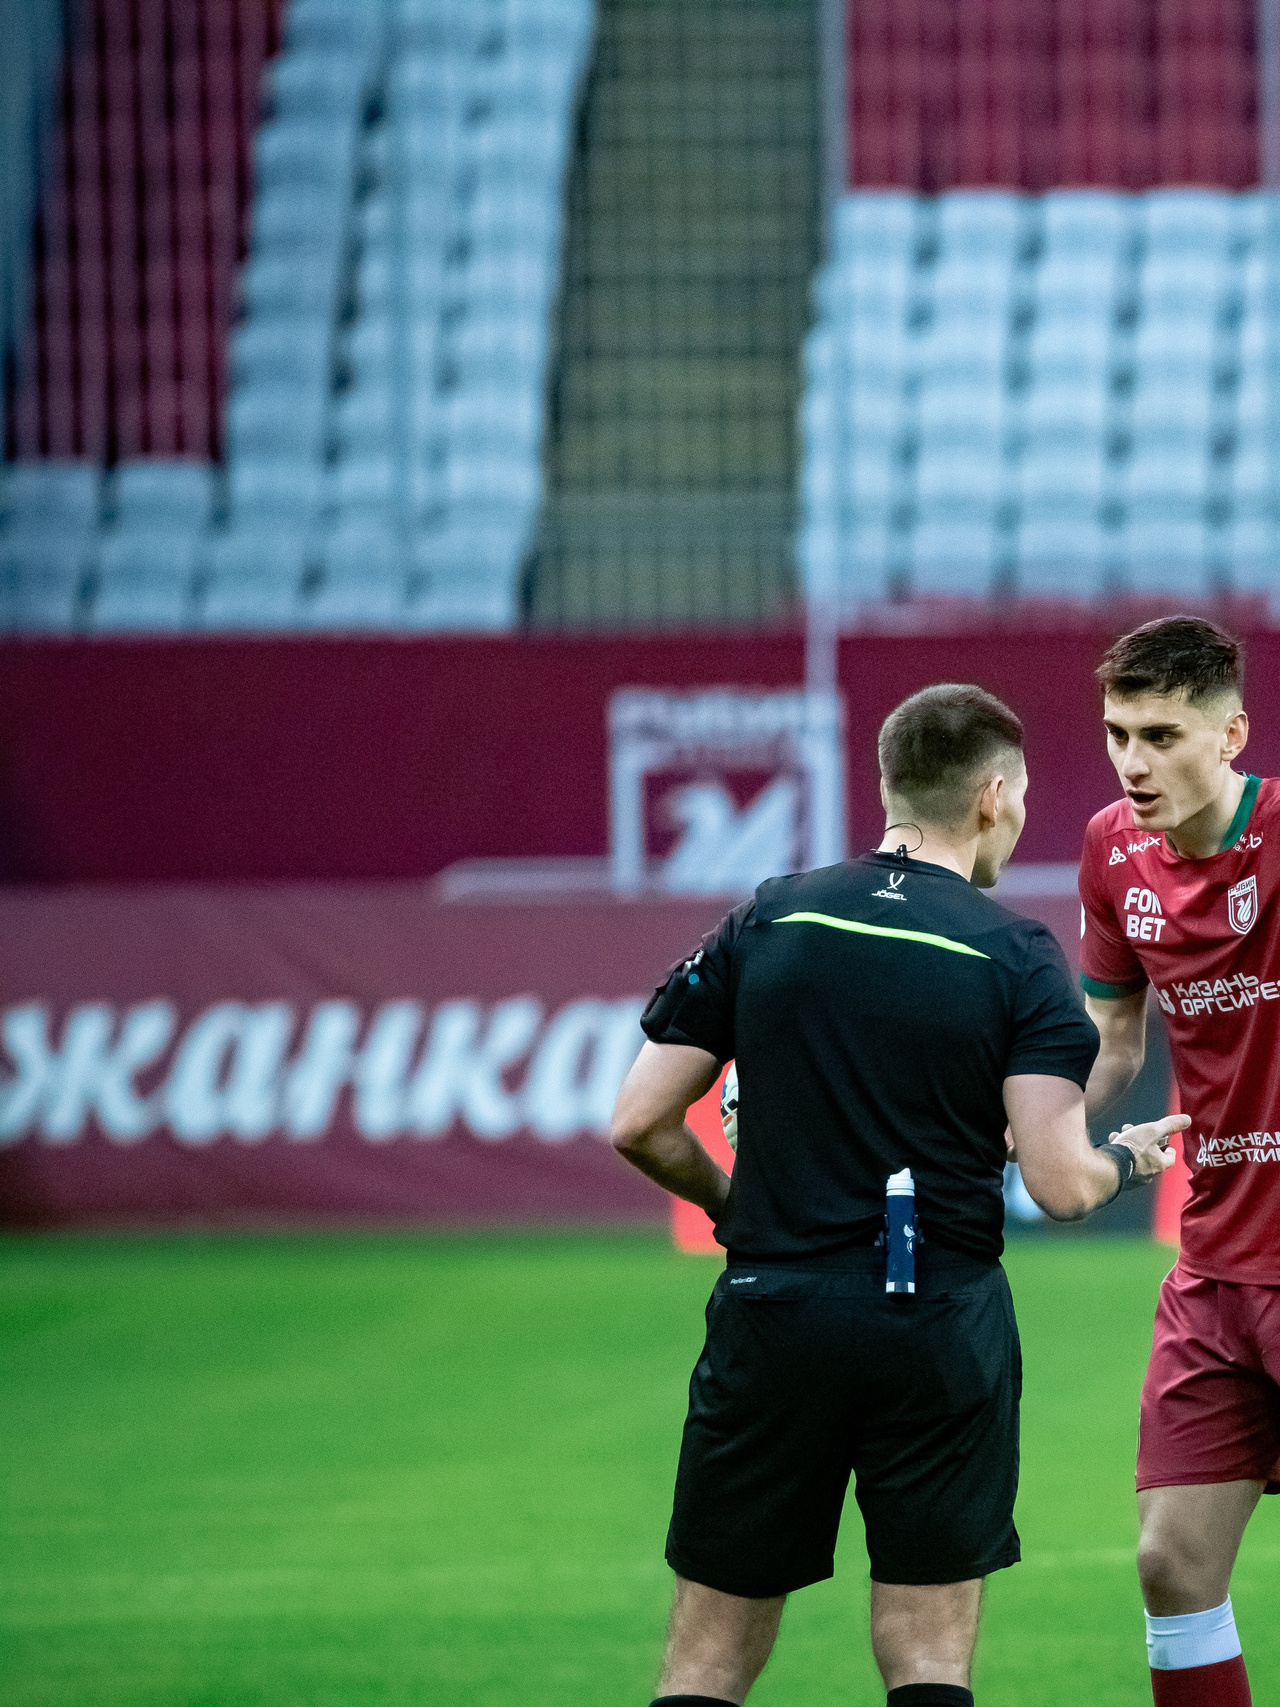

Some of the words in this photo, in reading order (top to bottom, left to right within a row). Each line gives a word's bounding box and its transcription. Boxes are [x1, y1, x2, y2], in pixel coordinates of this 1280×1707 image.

[871, 889, 907, 901] JÖGEL
[1124, 887, 1162, 915] FON
[1126, 914, 1166, 941] BET
[1171, 972, 1259, 998] КАЗАНЬ
